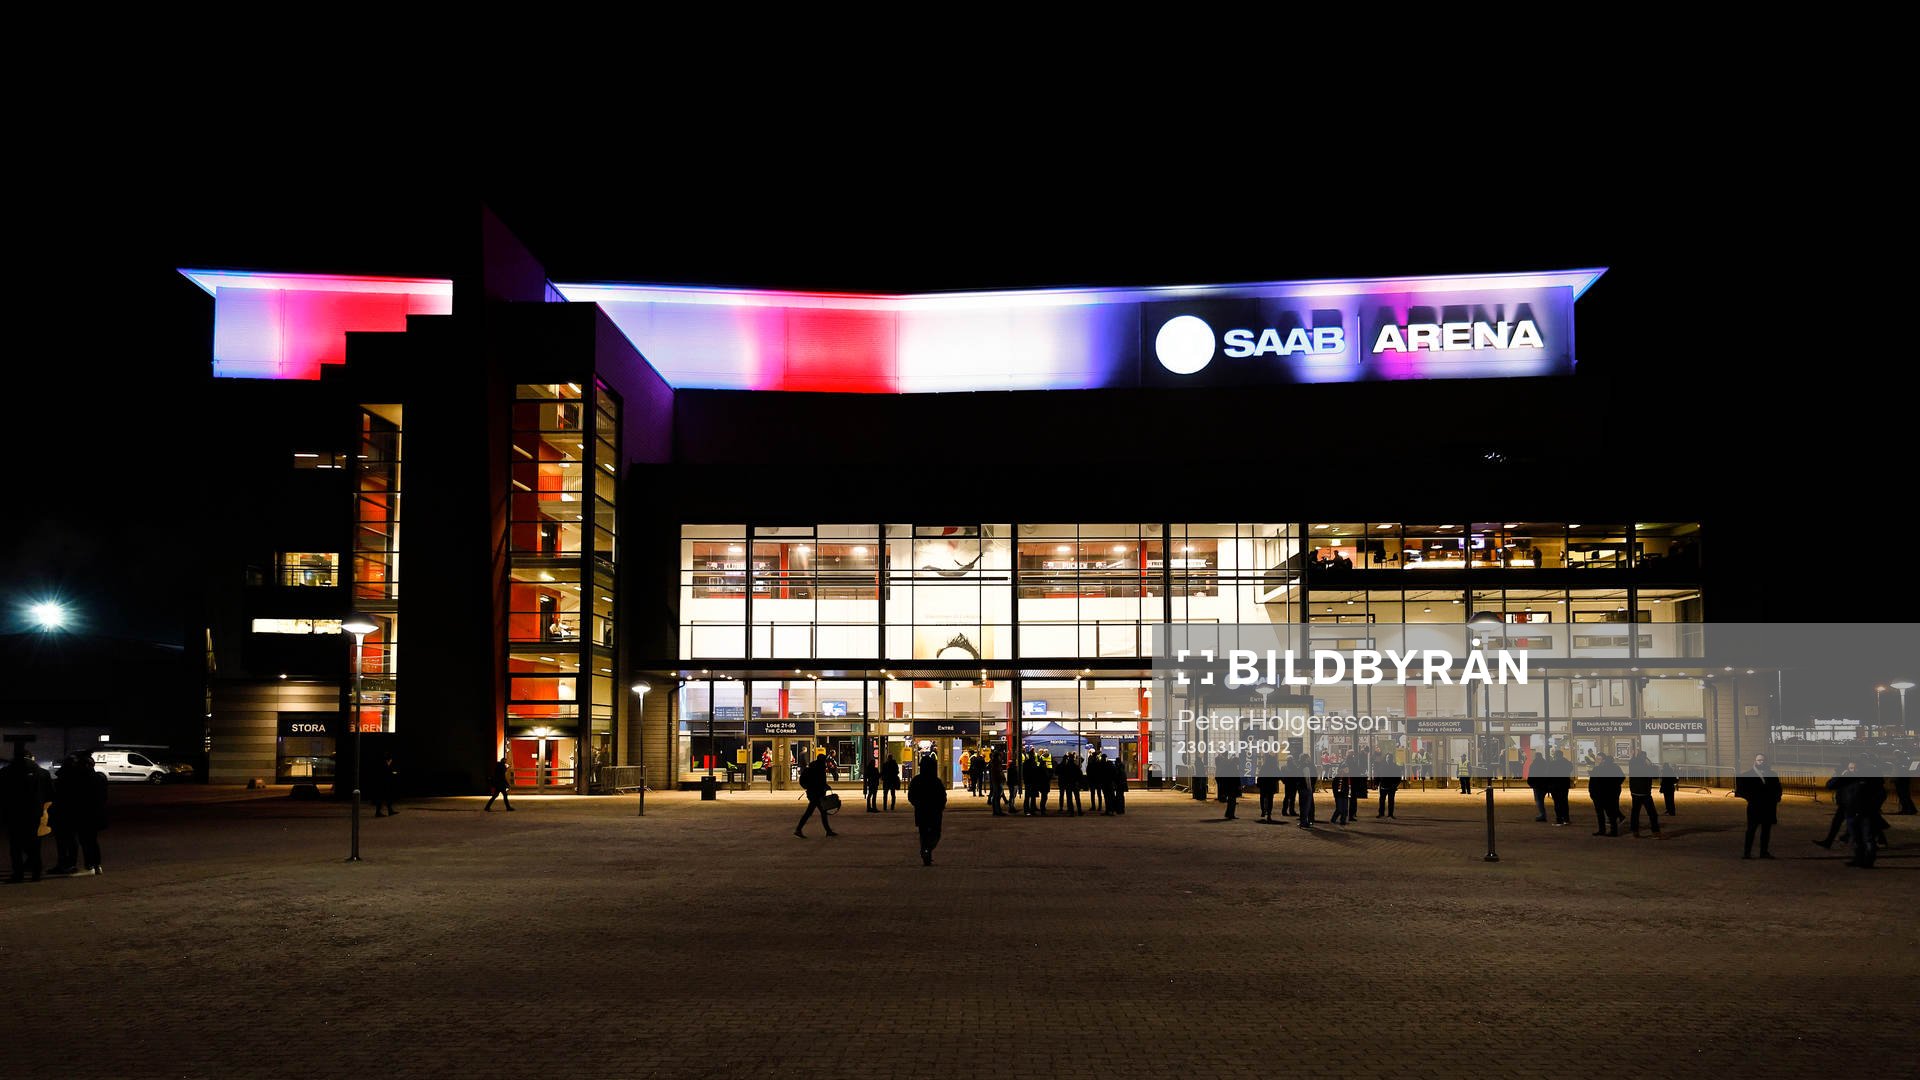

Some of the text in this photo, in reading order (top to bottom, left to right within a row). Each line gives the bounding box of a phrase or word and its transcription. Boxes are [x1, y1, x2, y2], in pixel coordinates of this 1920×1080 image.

[1224, 320, 1544, 358] SAAB ARENA
[291, 723, 326, 732] STORA
[1645, 722, 1703, 730] KUNDCENTER
